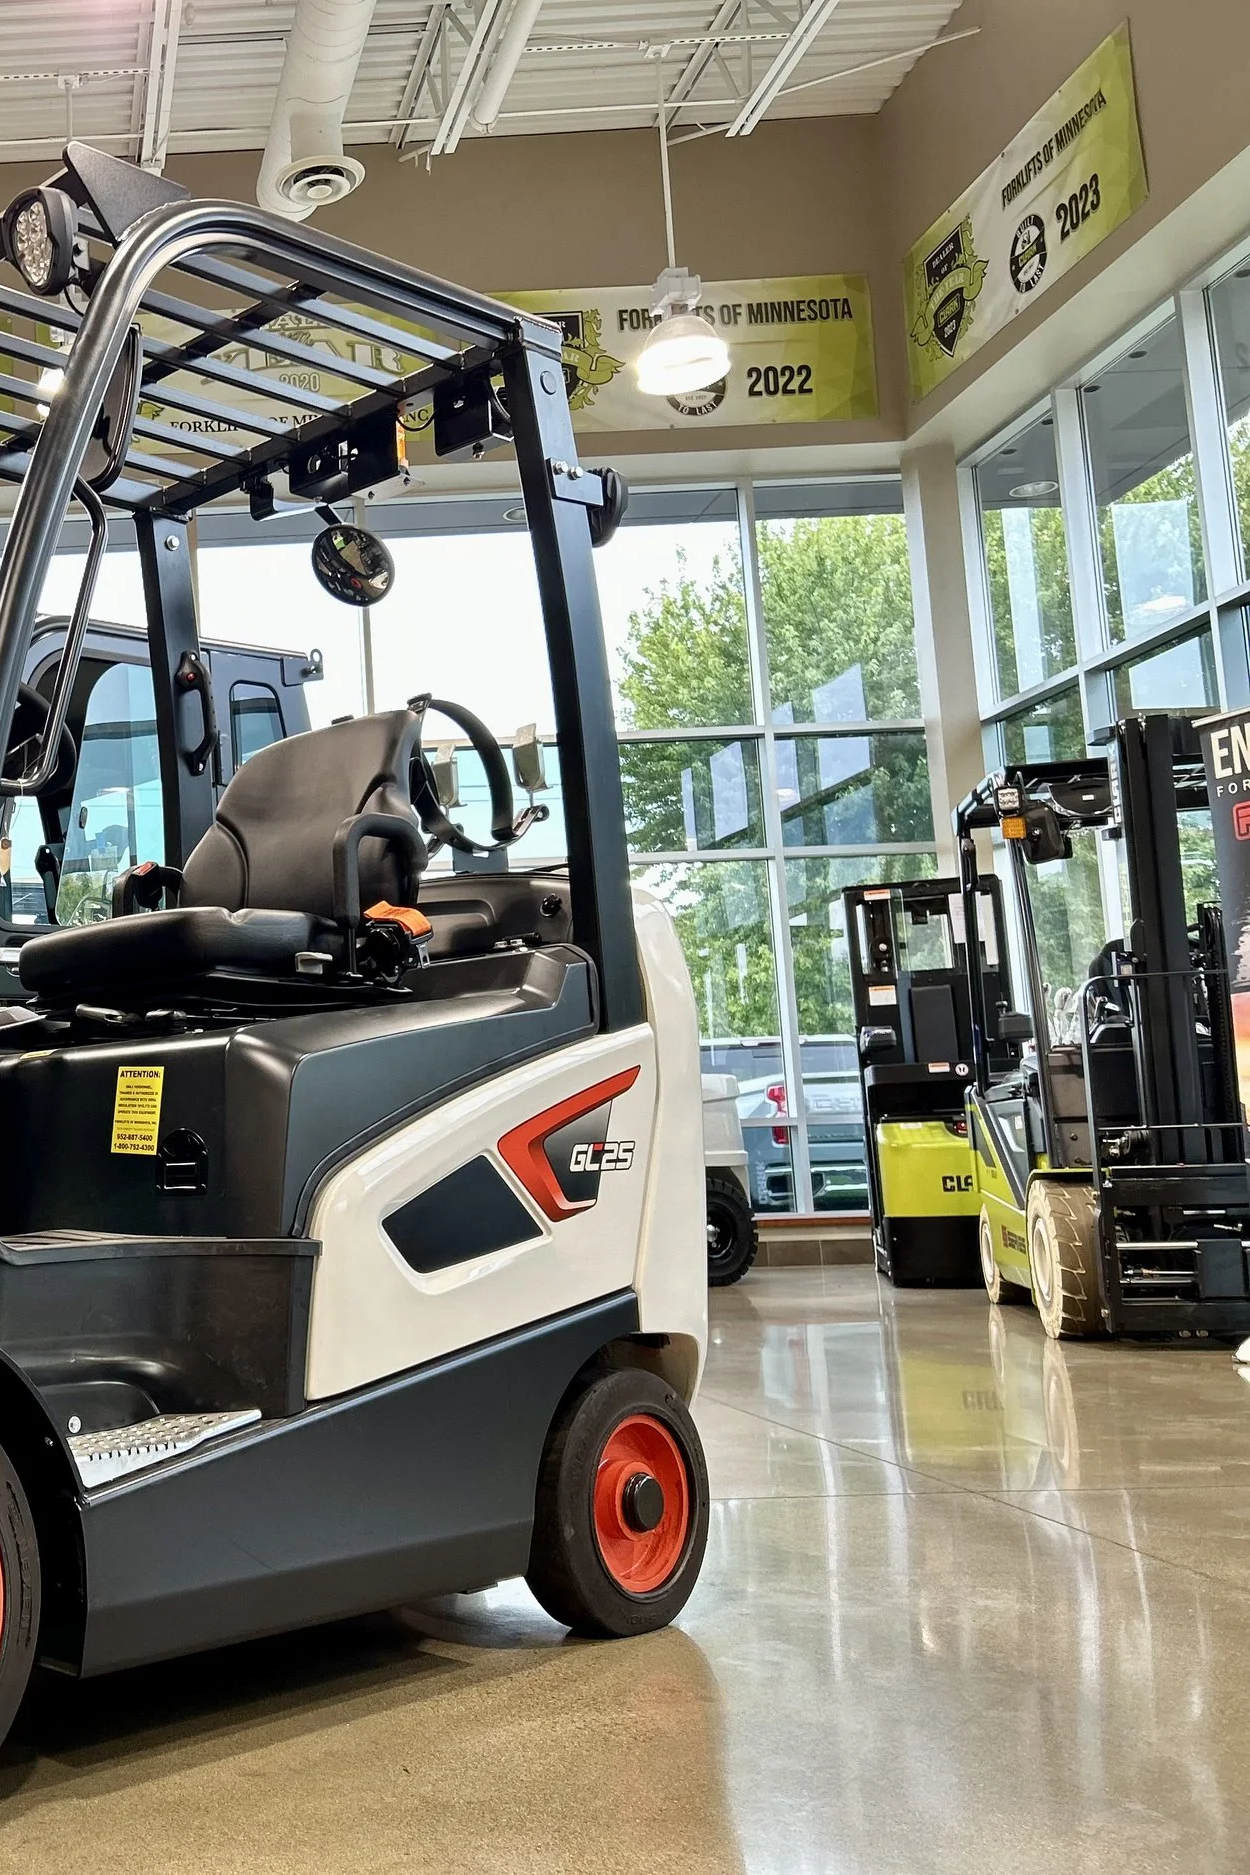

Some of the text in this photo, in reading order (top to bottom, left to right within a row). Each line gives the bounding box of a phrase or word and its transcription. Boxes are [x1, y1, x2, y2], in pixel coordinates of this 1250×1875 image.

[1001, 88, 1107, 210] FORKLIFTS OF MINNESOTA
[1056, 173, 1101, 244] 2023
[618, 298, 853, 331] FORTS OF MINNESOTA
[746, 365, 813, 397] 2022
[678, 401, 718, 415] TO LAST
[120, 1070, 161, 1078] ATTENTION:
